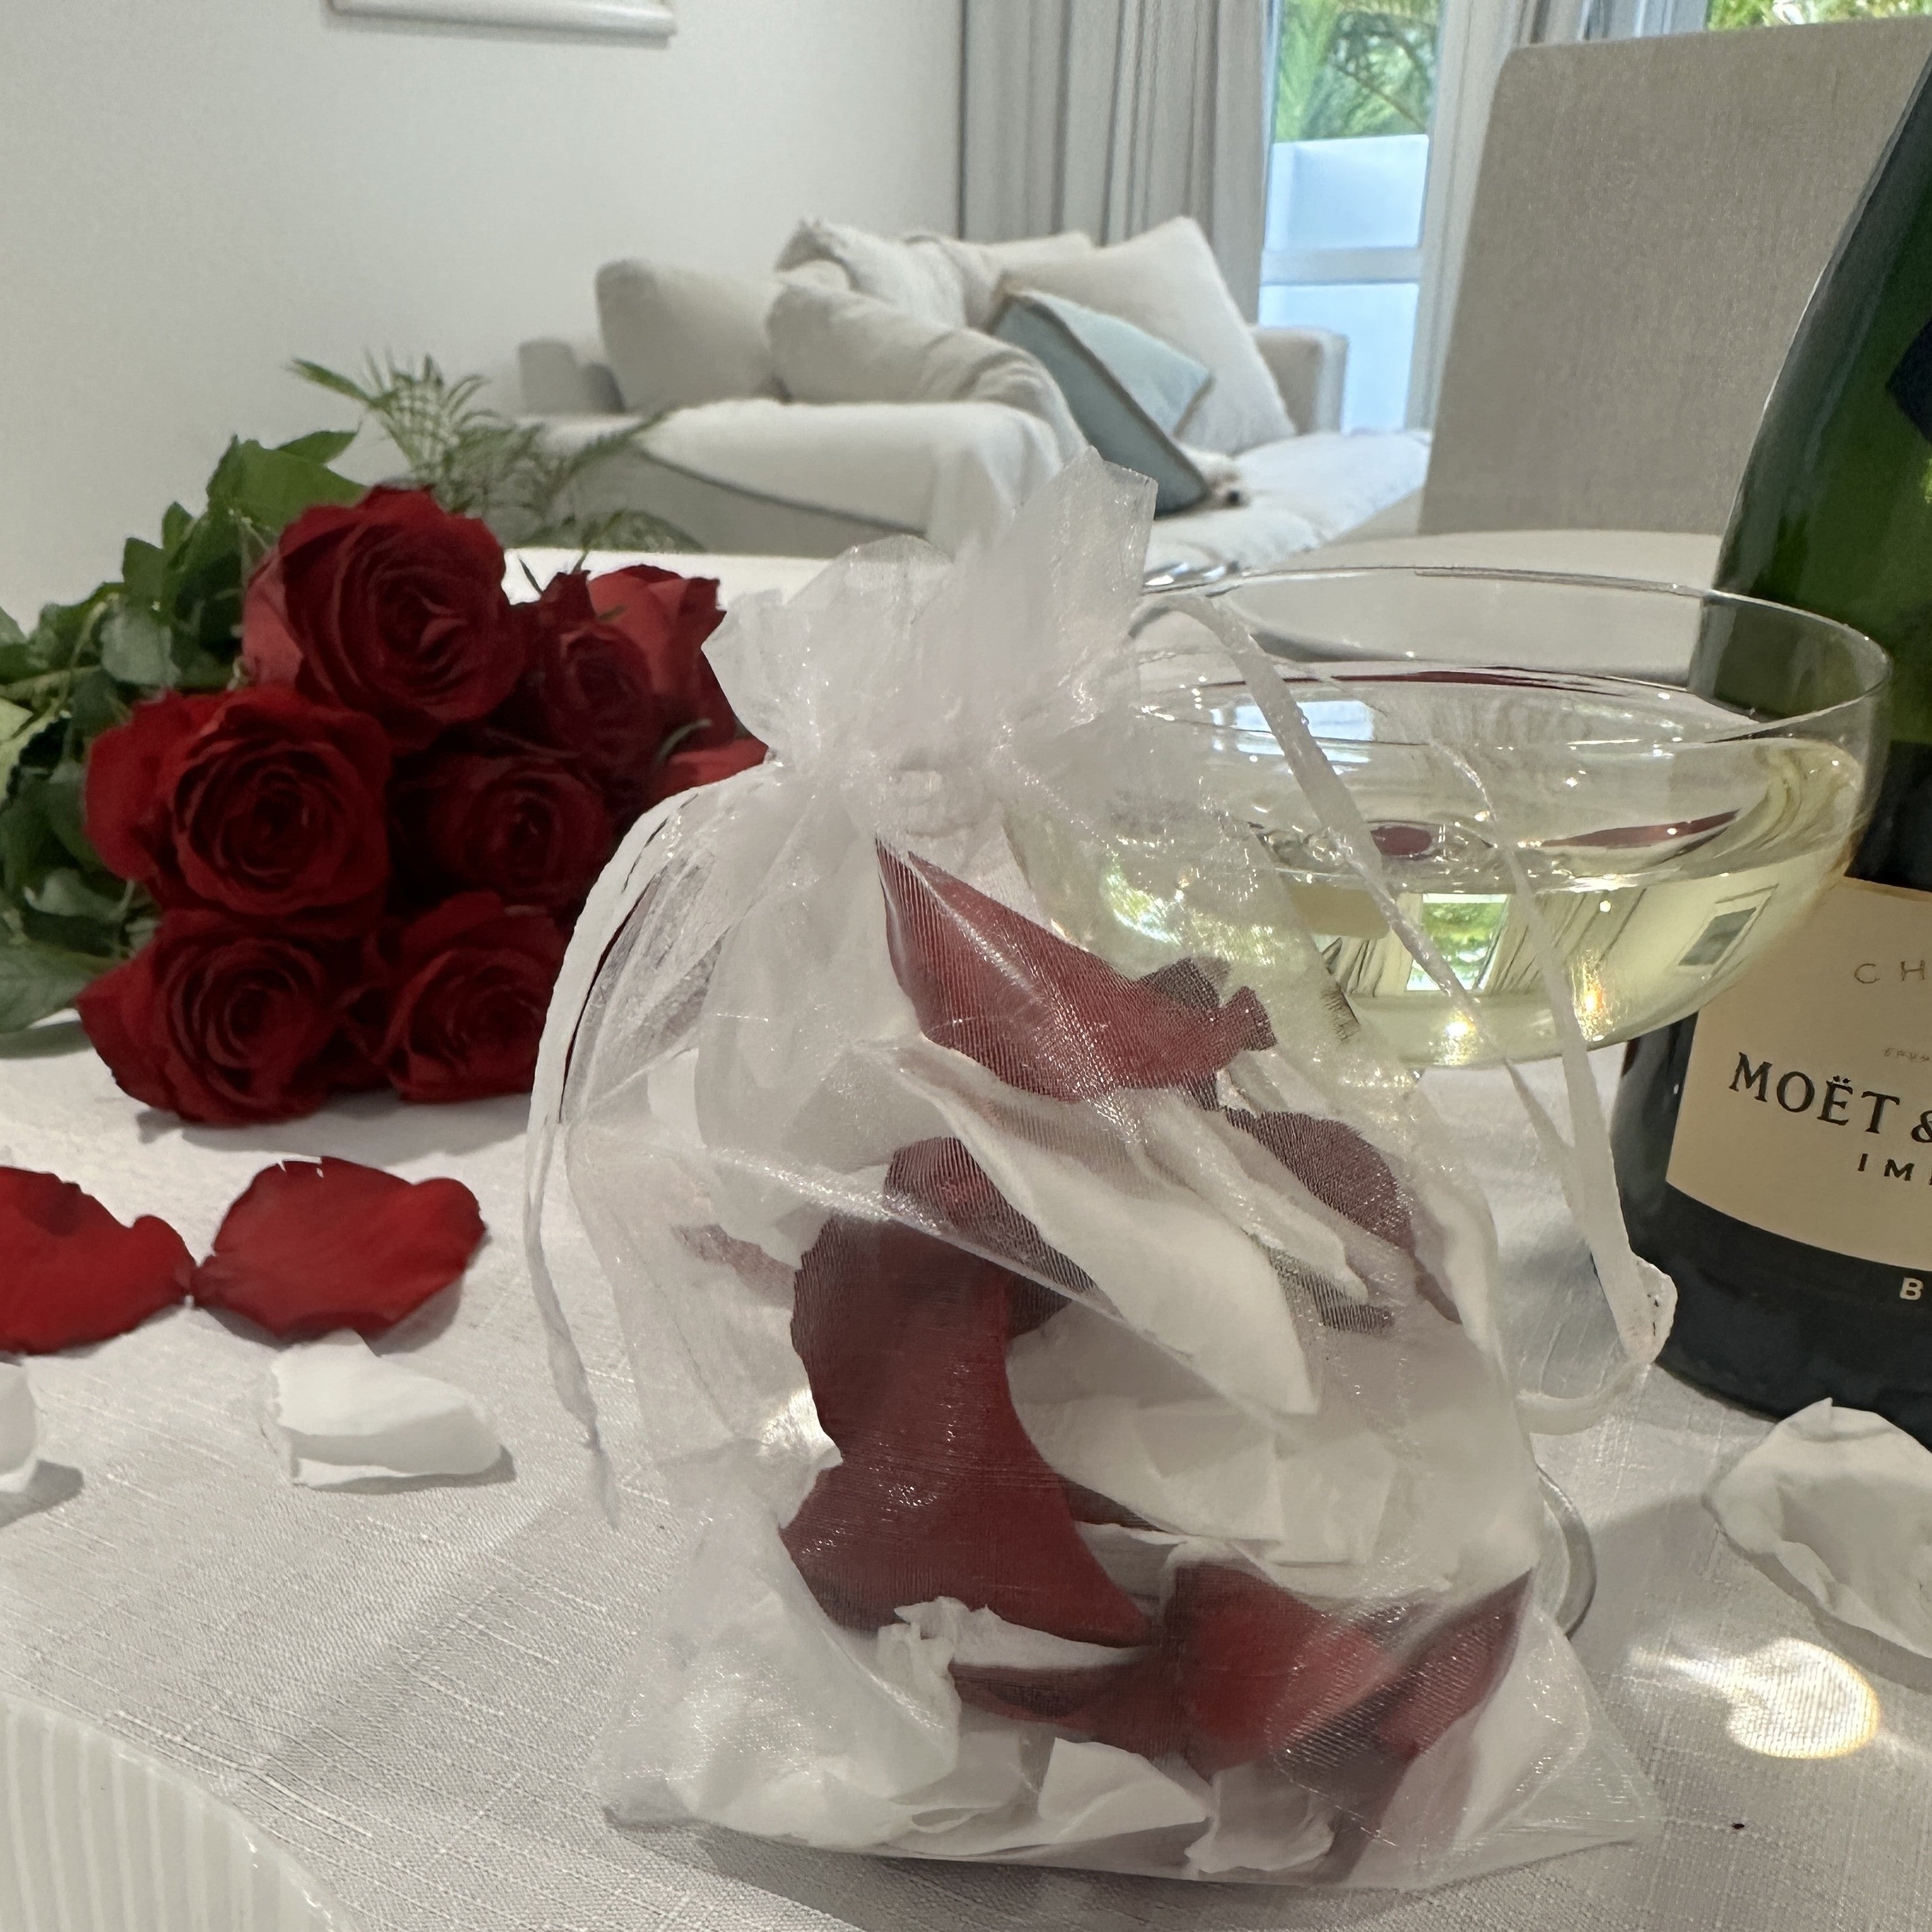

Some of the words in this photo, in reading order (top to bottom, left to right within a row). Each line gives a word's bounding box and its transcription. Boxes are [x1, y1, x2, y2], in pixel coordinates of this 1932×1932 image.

[1854, 959, 1925, 984] CH
[1729, 1051, 1900, 1134] MOËT
[1857, 1153, 1932, 1185] IM
[1899, 1277, 1924, 1300] B
